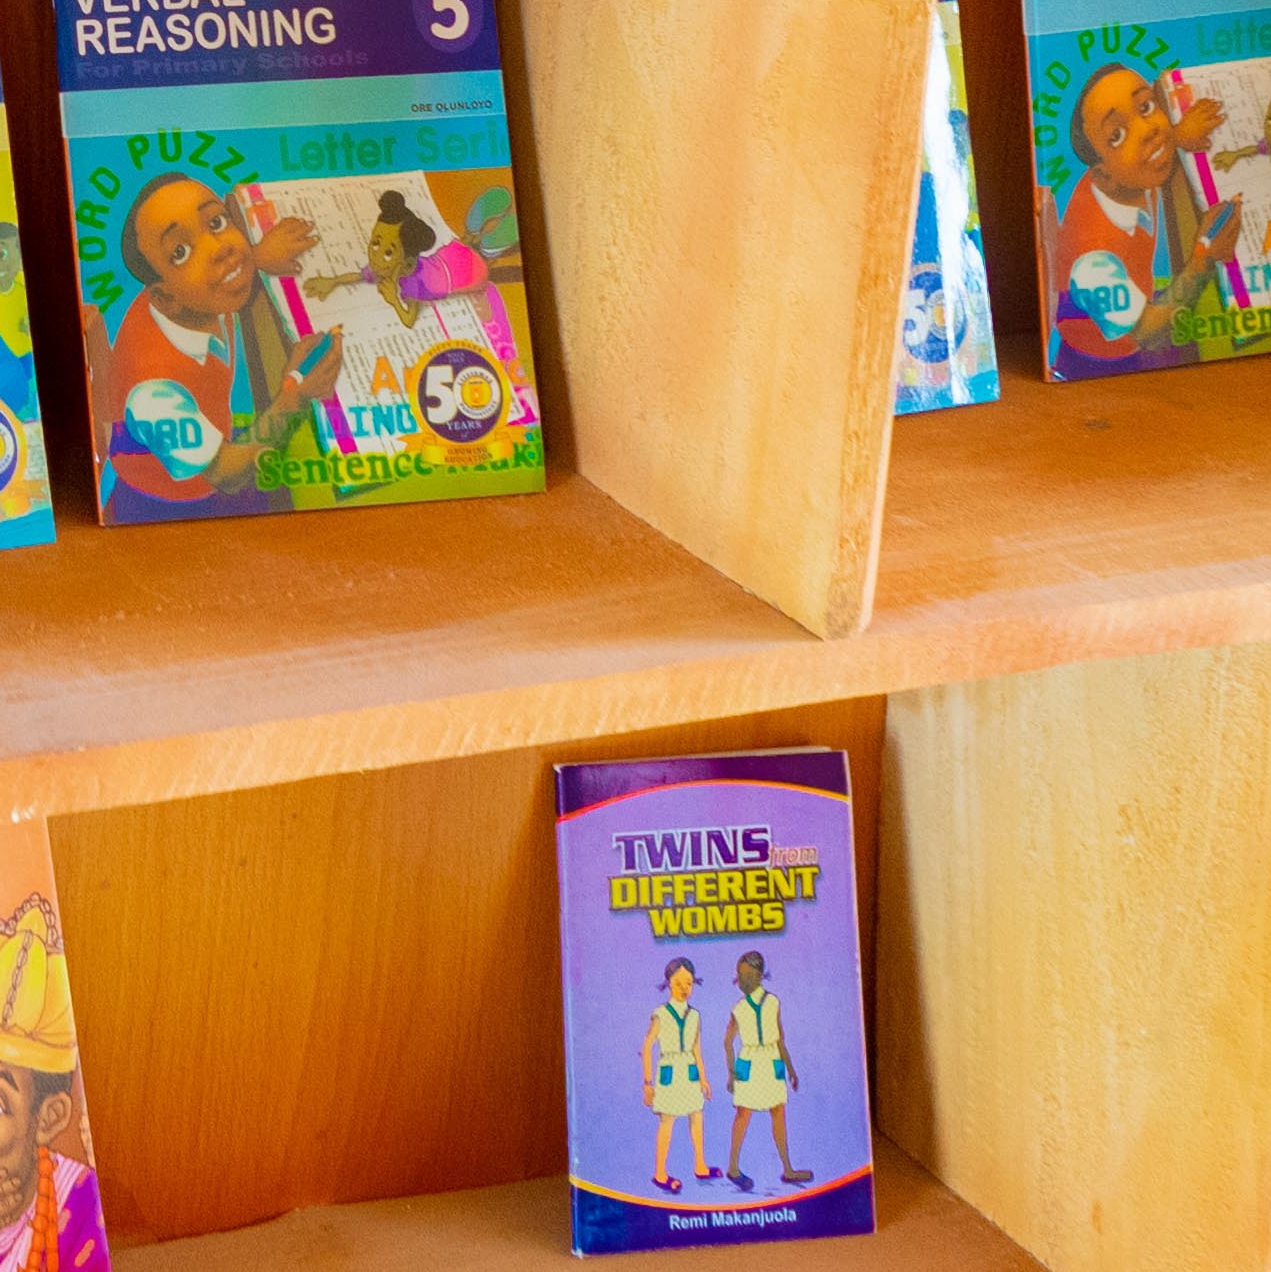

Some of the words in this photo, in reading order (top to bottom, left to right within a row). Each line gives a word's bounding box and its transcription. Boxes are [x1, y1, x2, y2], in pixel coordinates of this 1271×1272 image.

[76, 7, 336, 56] REASONING
[613, 826, 772, 874] TWINS
[769, 845, 816, 867] from
[610, 866, 819, 910] DIFFERENT
[650, 902, 785, 938] WOMBS
[669, 1212, 708, 1230] Remi
[712, 1208, 797, 1228] Makanjuola
